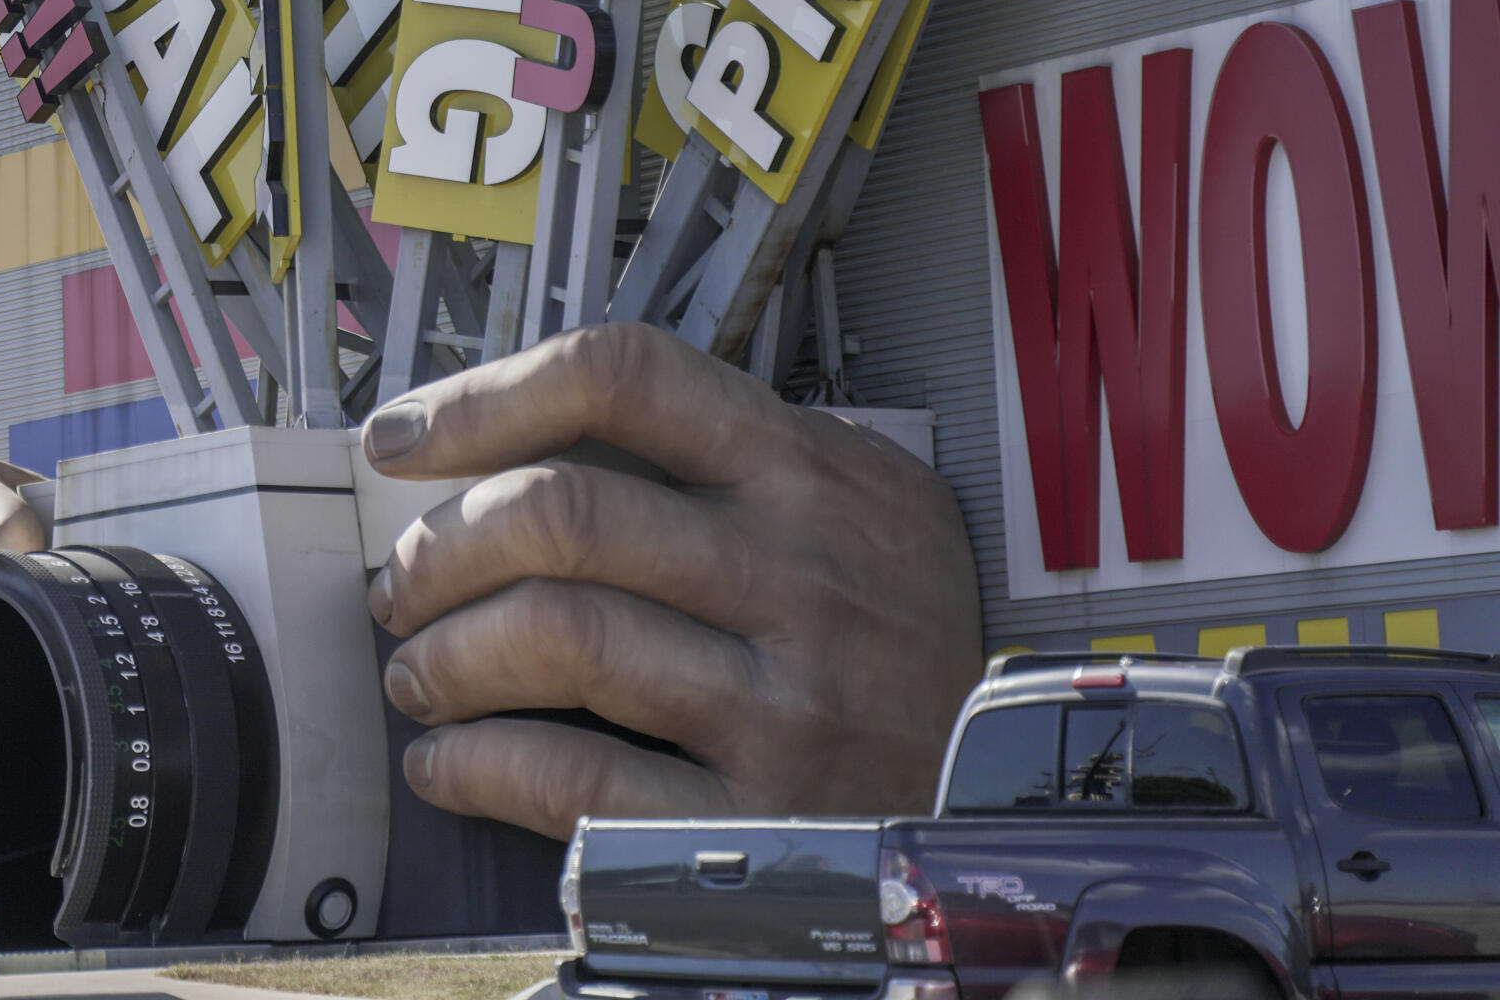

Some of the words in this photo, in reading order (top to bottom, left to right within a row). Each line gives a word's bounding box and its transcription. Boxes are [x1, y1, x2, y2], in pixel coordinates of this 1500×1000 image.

[119, 581, 143, 597] 16
[87, 595, 108, 605] 2
[207, 607, 226, 618] 8
[99, 614, 125, 637] 1.5
[214, 621, 236, 638] 11
[224, 642, 245, 664] 16
[115, 652, 139, 680] 1.2
[127, 704, 146, 716] 1
[131, 740, 151, 772] 0.9
[128, 797, 149, 828] 0.8
[957, 876, 1024, 899] TRD
[1015, 903, 1056, 911] ROAD
[589, 934, 649, 946] TACOMA
